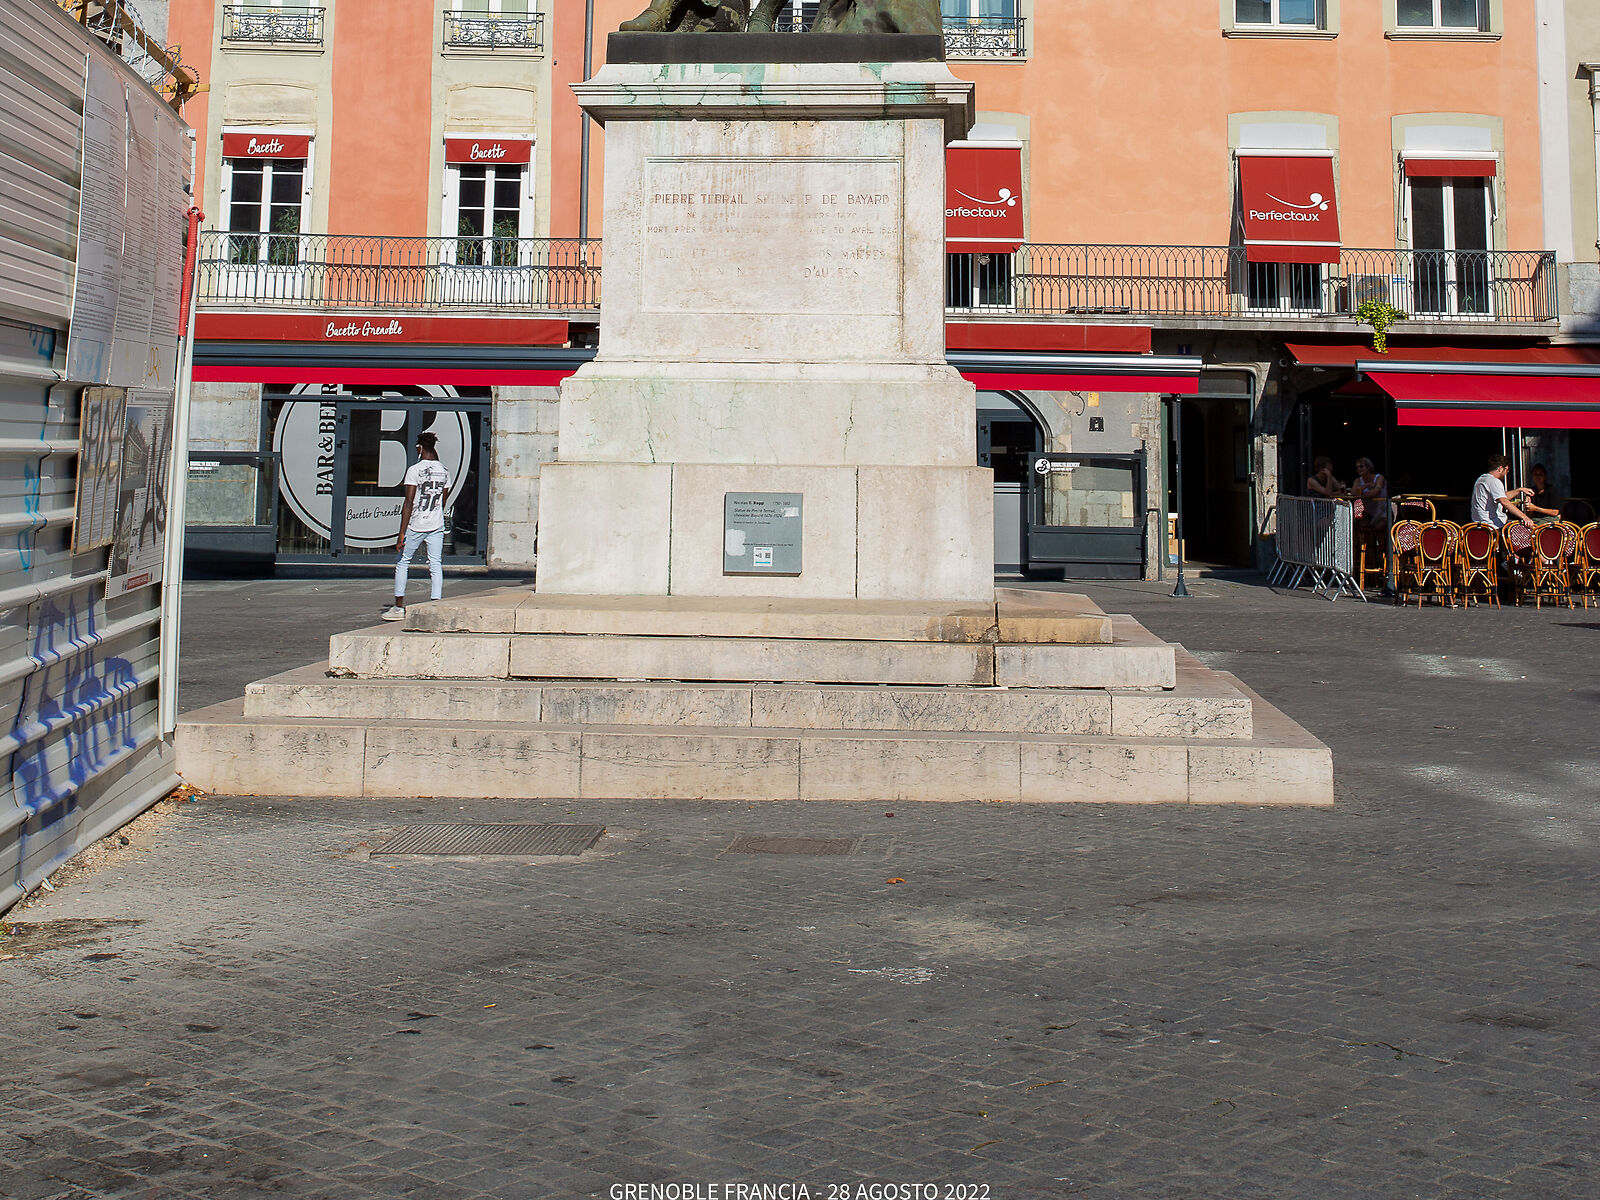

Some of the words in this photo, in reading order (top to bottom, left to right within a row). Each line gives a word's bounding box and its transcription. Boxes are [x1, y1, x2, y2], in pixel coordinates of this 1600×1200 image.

[247, 137, 285, 155] Bacetto
[470, 143, 507, 160] Bacetto
[655, 193, 695, 205] PIERRE
[822, 194, 838, 205] DE
[847, 193, 890, 205] BAYARD
[945, 206, 1007, 218] erfectaux
[1249, 209, 1320, 222] Perfectaux
[325, 321, 361, 338] Bacetto
[361, 319, 403, 337] Grenoble
[346, 508, 372, 521] Bacetto
[373, 504, 402, 519] Grenobl
